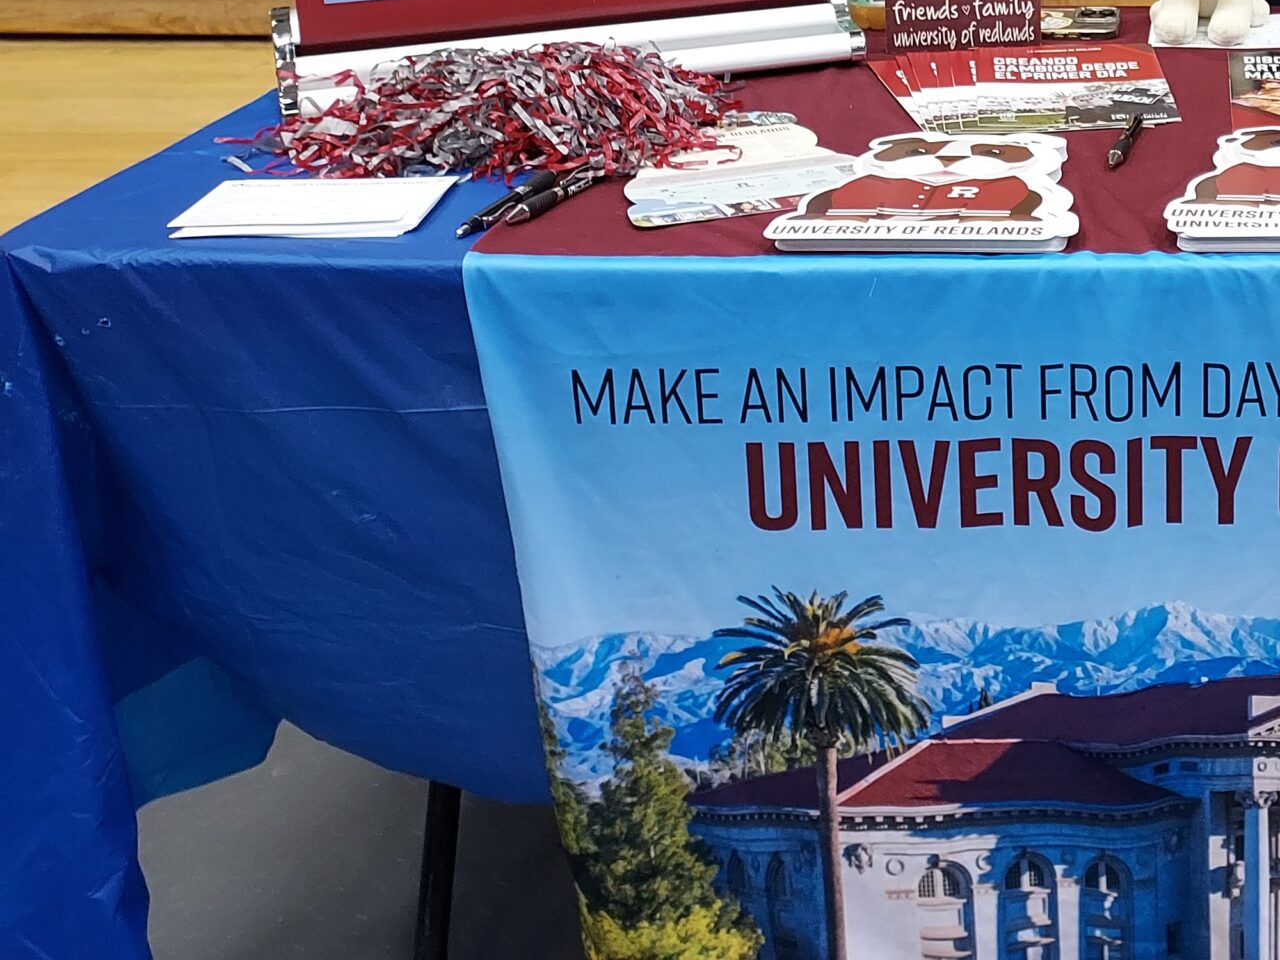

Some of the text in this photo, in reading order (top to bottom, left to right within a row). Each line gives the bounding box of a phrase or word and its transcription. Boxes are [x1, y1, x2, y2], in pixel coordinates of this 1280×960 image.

[893, 20, 1035, 51] university of redlands
[993, 56, 1078, 65] CREANDO
[994, 61, 1140, 73] CAMBIOS DESDE
[994, 71, 1016, 80] EL
[1020, 71, 1093, 80] PRIMER
[947, 186, 980, 198] R
[772, 225, 1045, 236] UNIVERSITY OF REDLANDS
[570, 366, 725, 426] MAKE
[740, 366, 810, 425] AN
[829, 363, 1024, 423] IMPACT
[1039, 361, 1184, 420] FROM
[744, 433, 1256, 532] UNIVERSITY
